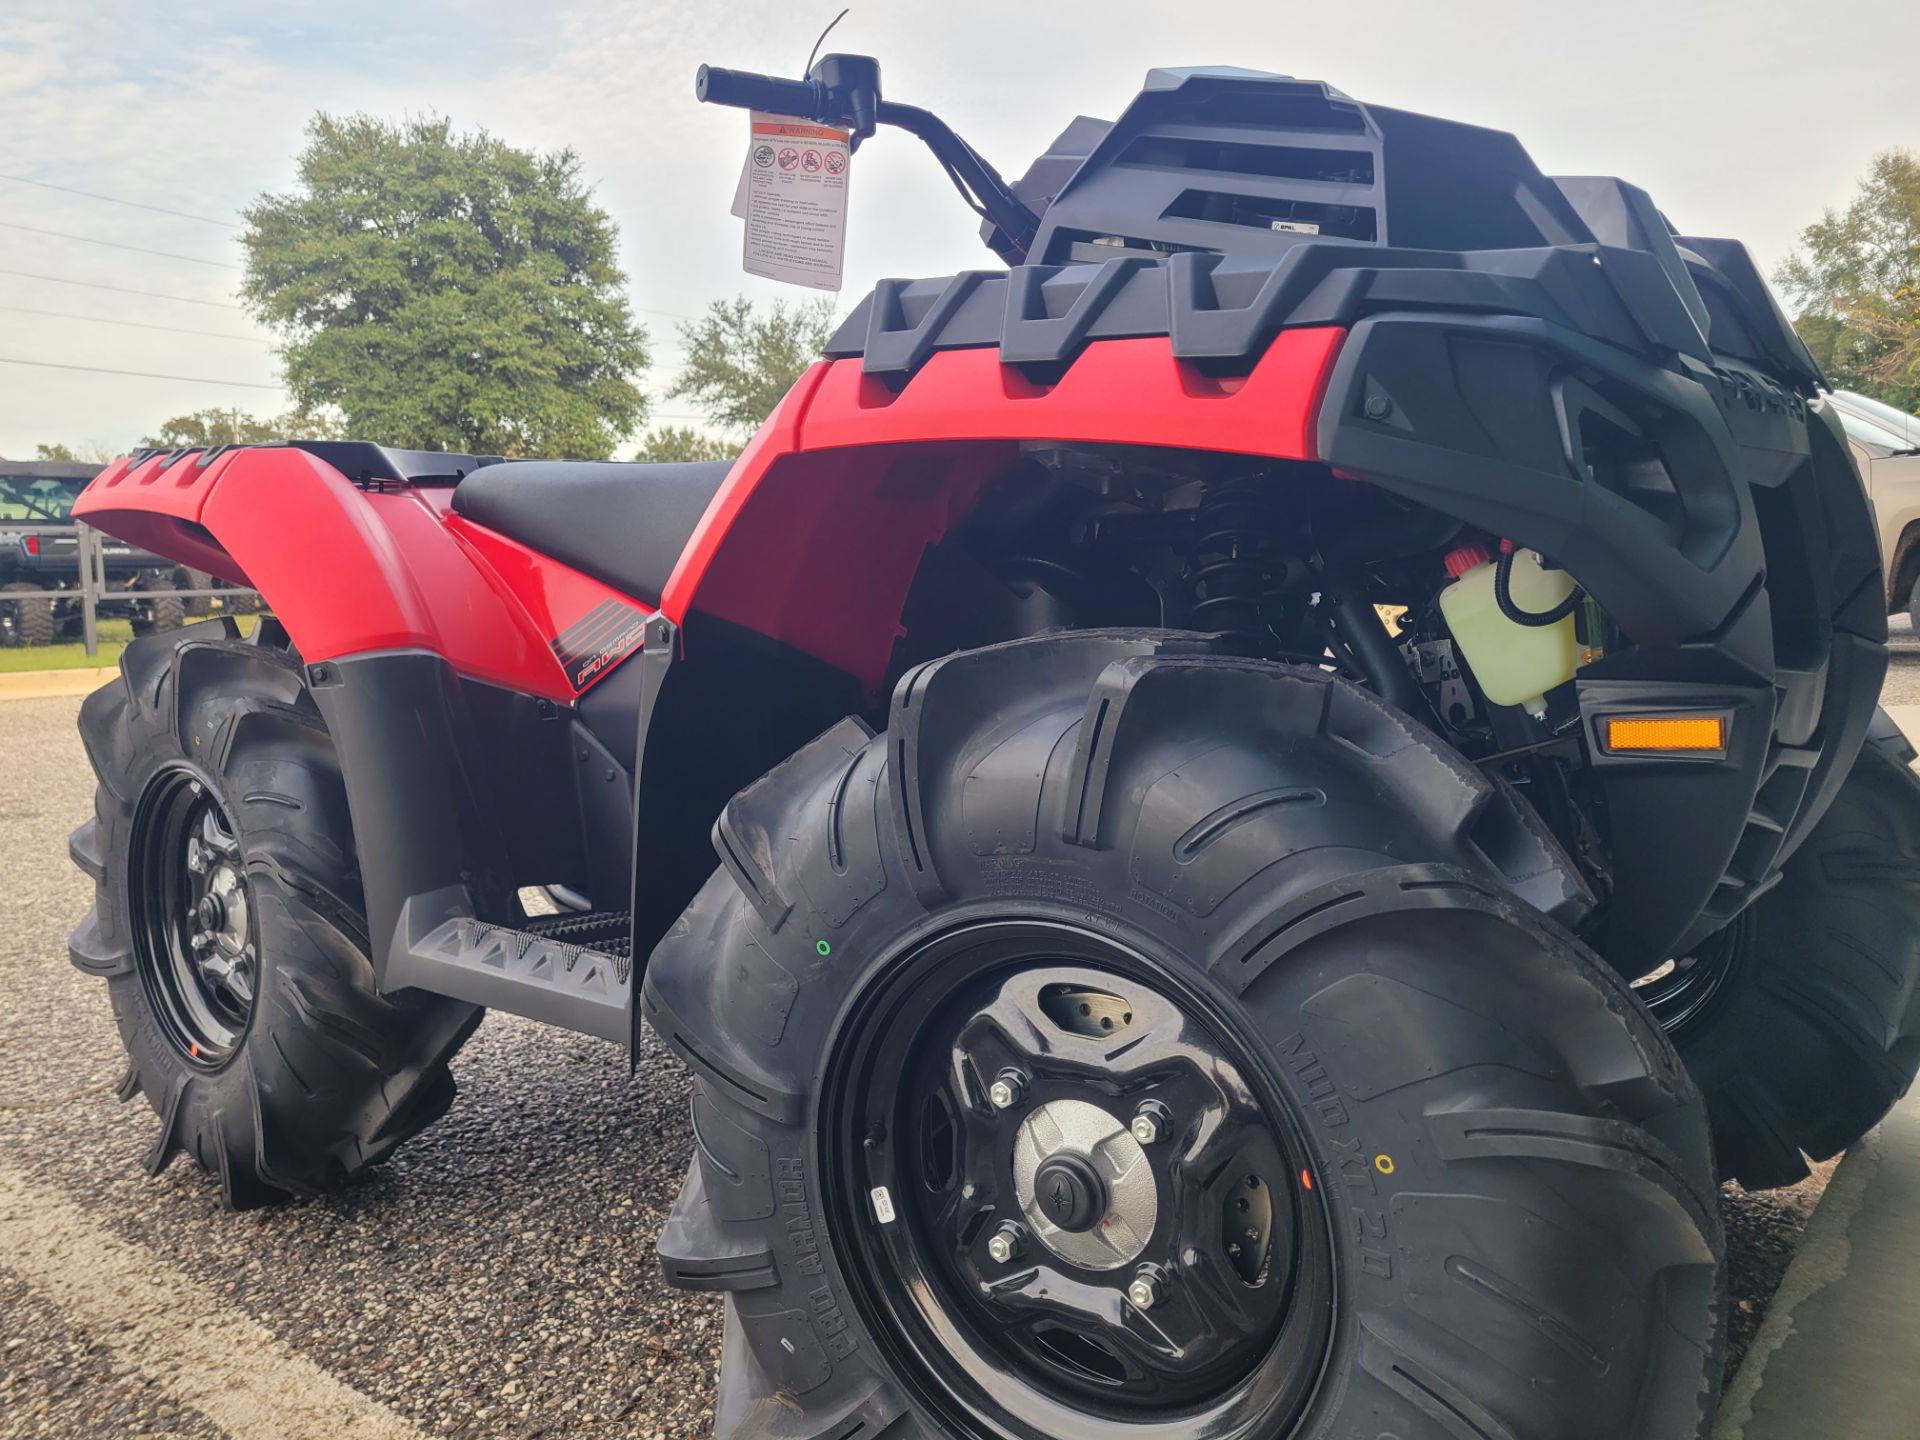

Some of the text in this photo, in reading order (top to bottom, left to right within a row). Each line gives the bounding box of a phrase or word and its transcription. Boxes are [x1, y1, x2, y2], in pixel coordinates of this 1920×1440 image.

[788, 127, 824, 137] WARNING
[1277, 1031, 1392, 1280] MUD XT 2.0
[776, 1157, 860, 1363] PRO ARMOR
